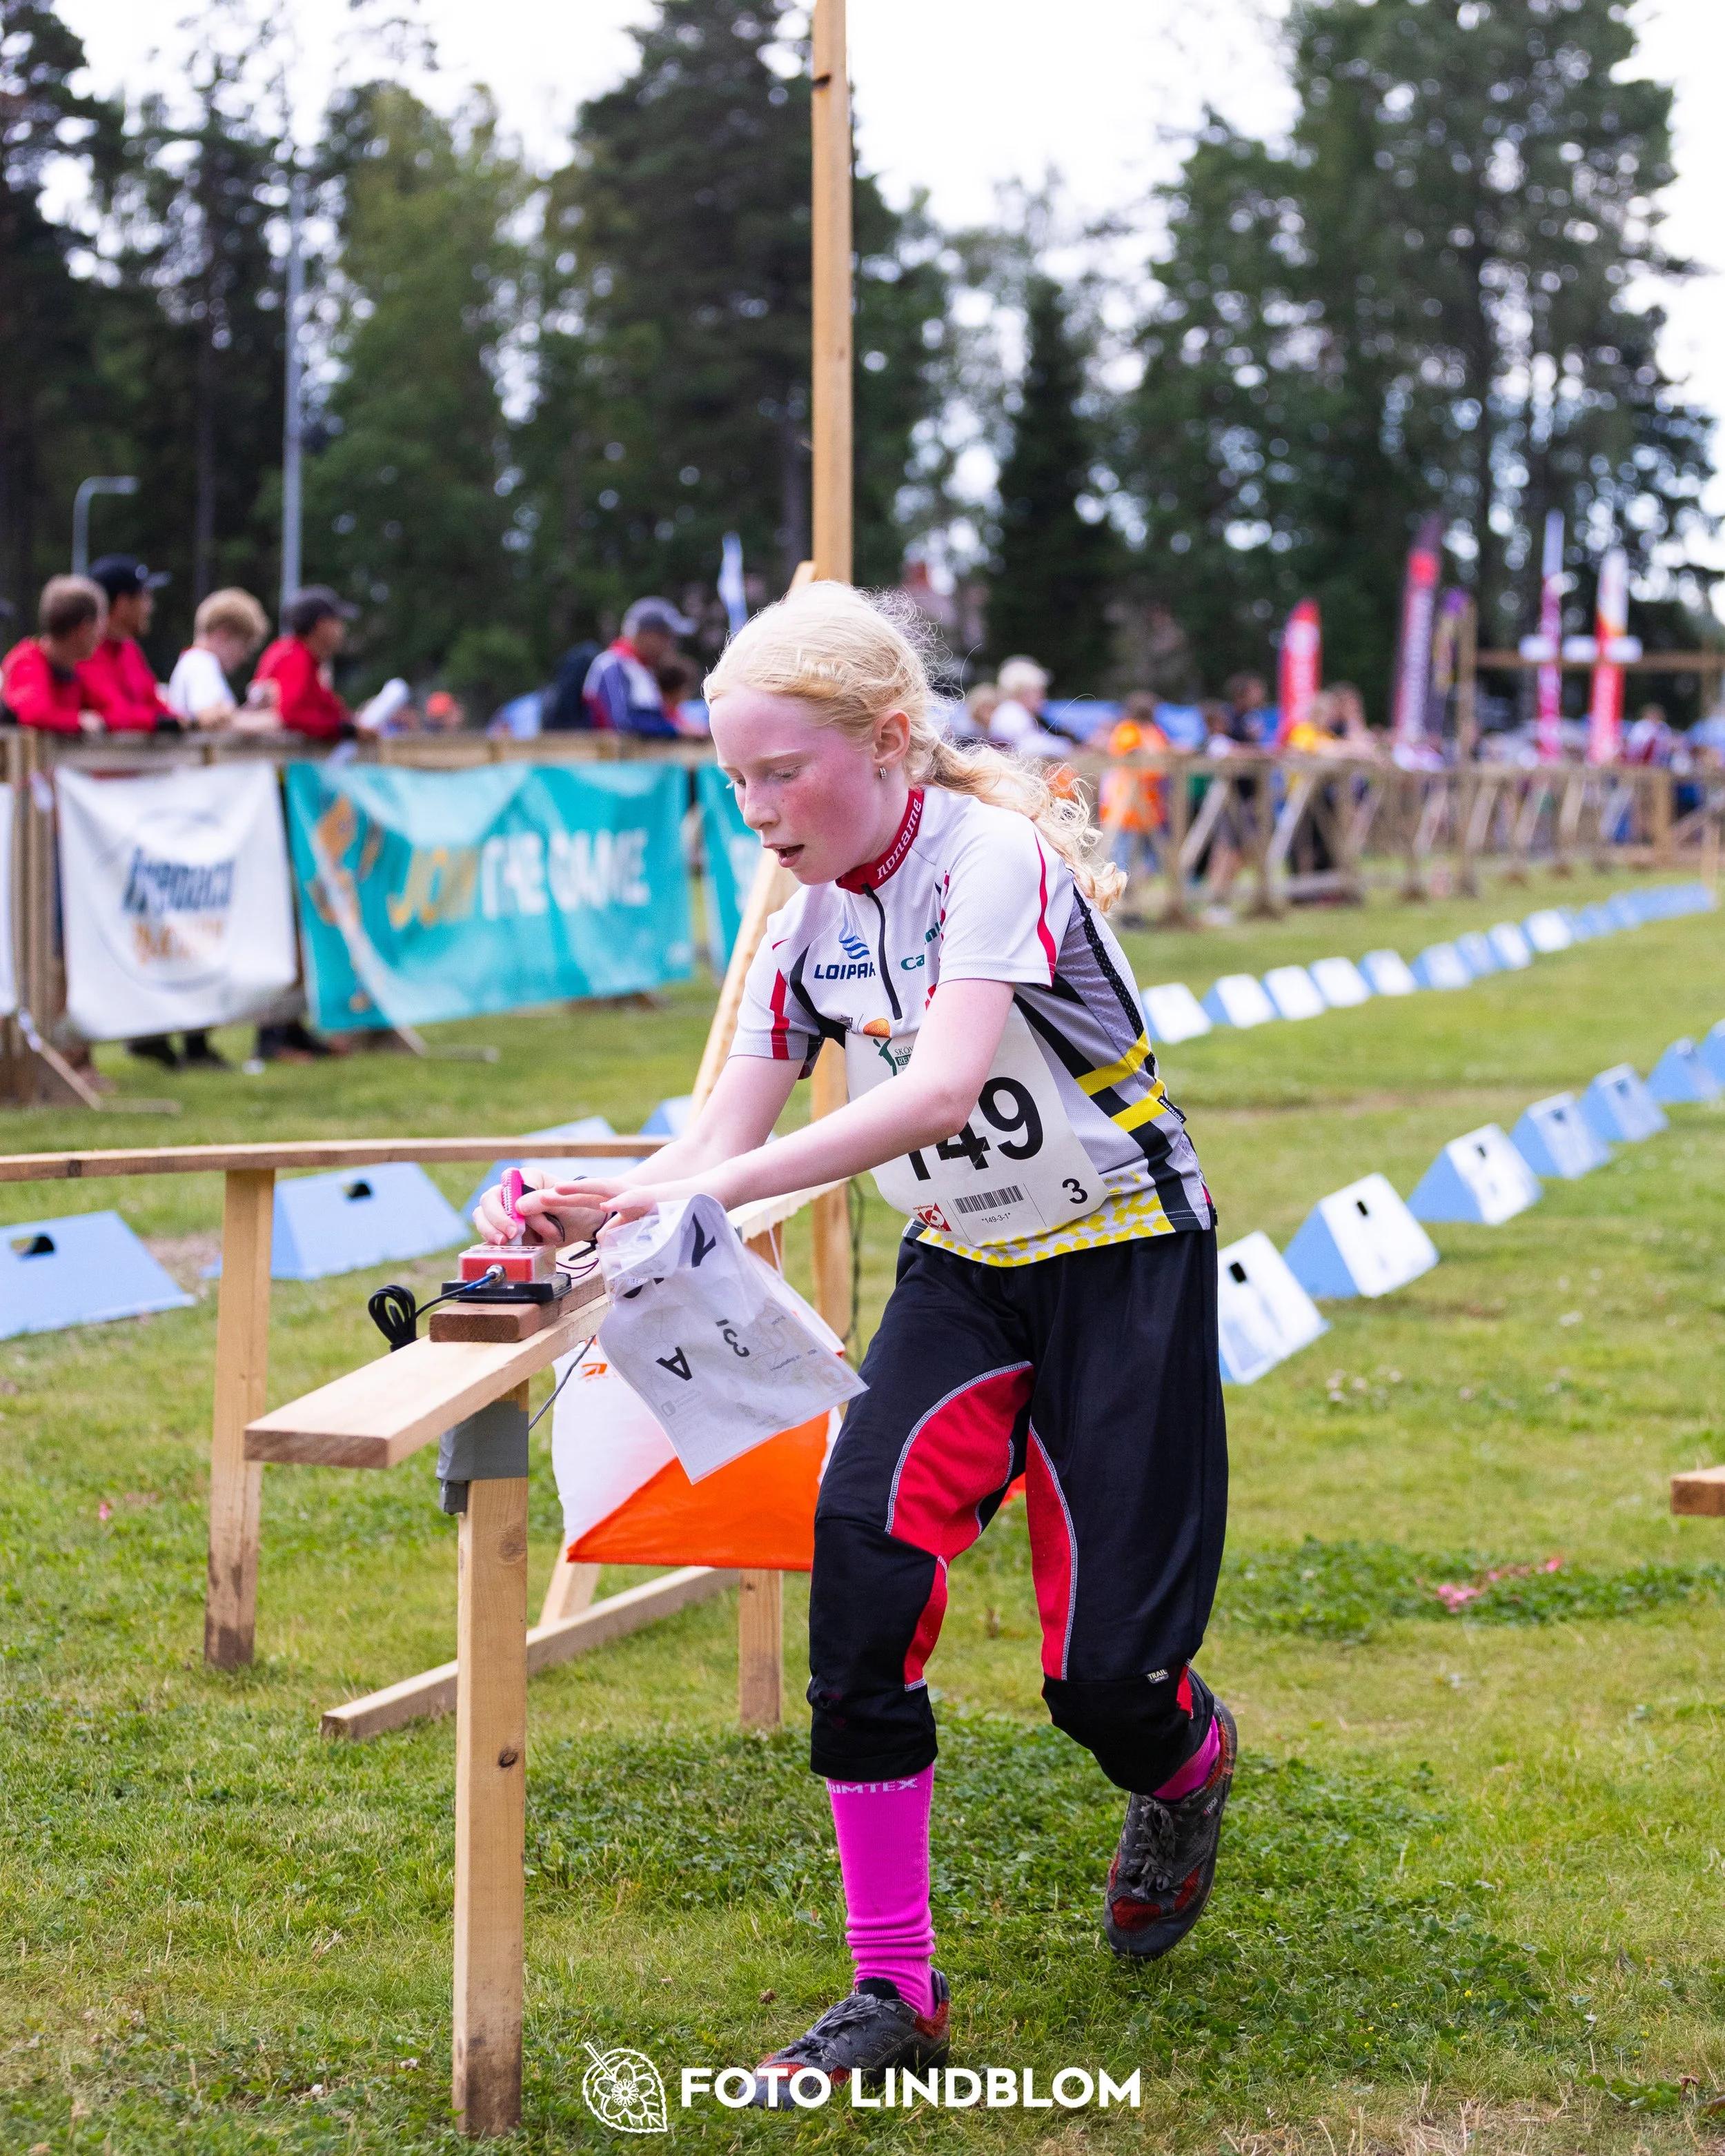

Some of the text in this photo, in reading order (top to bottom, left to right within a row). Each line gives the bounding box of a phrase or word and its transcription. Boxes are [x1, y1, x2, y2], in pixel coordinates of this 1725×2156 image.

[876, 798, 921, 880] noname
[1159, 1099, 1184, 1122] noname
[1062, 1178, 1088, 1205] 3
[656, 1346, 693, 1381] A
[1147, 1669, 1167, 1680] TRAIL
[827, 1778, 918, 1794] RIMTEX
